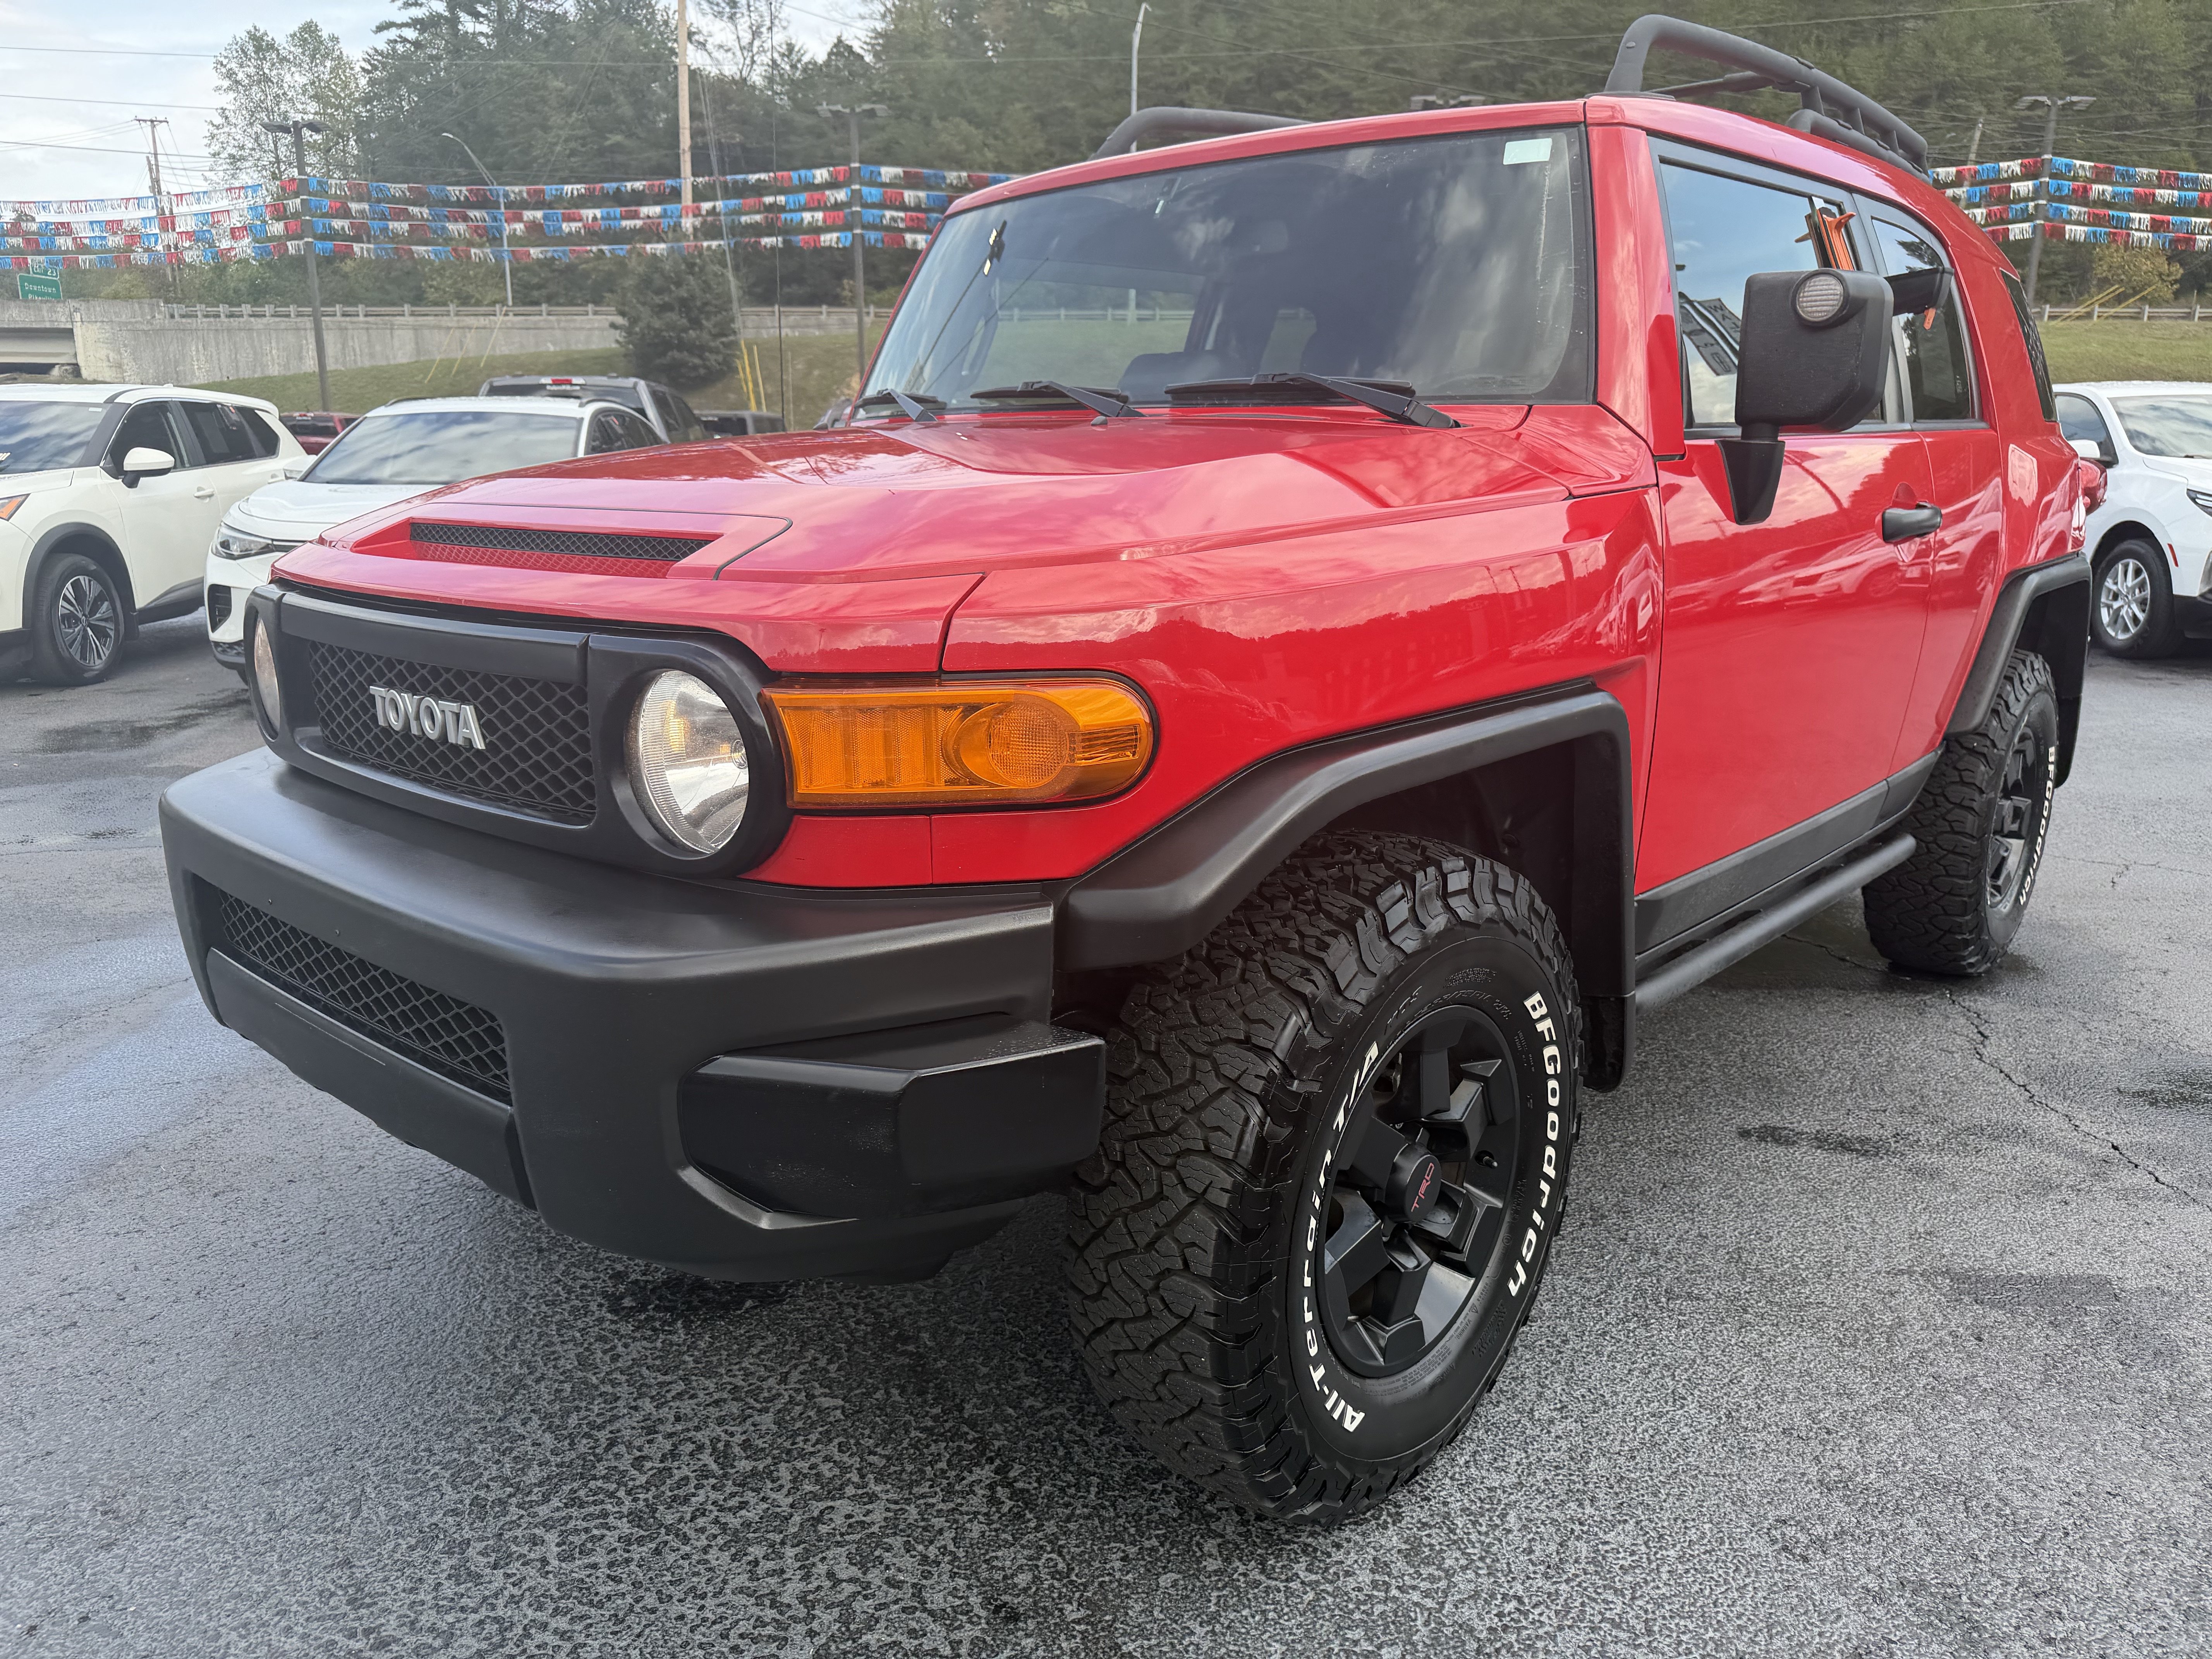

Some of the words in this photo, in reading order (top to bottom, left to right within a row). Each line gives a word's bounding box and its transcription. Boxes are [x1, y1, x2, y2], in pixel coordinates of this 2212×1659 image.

[25, 283, 56, 293] Downtown
[369, 685, 486, 749] TOYOTA
[2019, 746, 2055, 905] BFGoodrich
[1334, 1042, 1379, 1132] T/A
[1411, 1163, 1434, 1212] TRD
[1508, 991, 1561, 1297] BFGoodrich
[1304, 1149, 1365, 1432] All-Terrain
